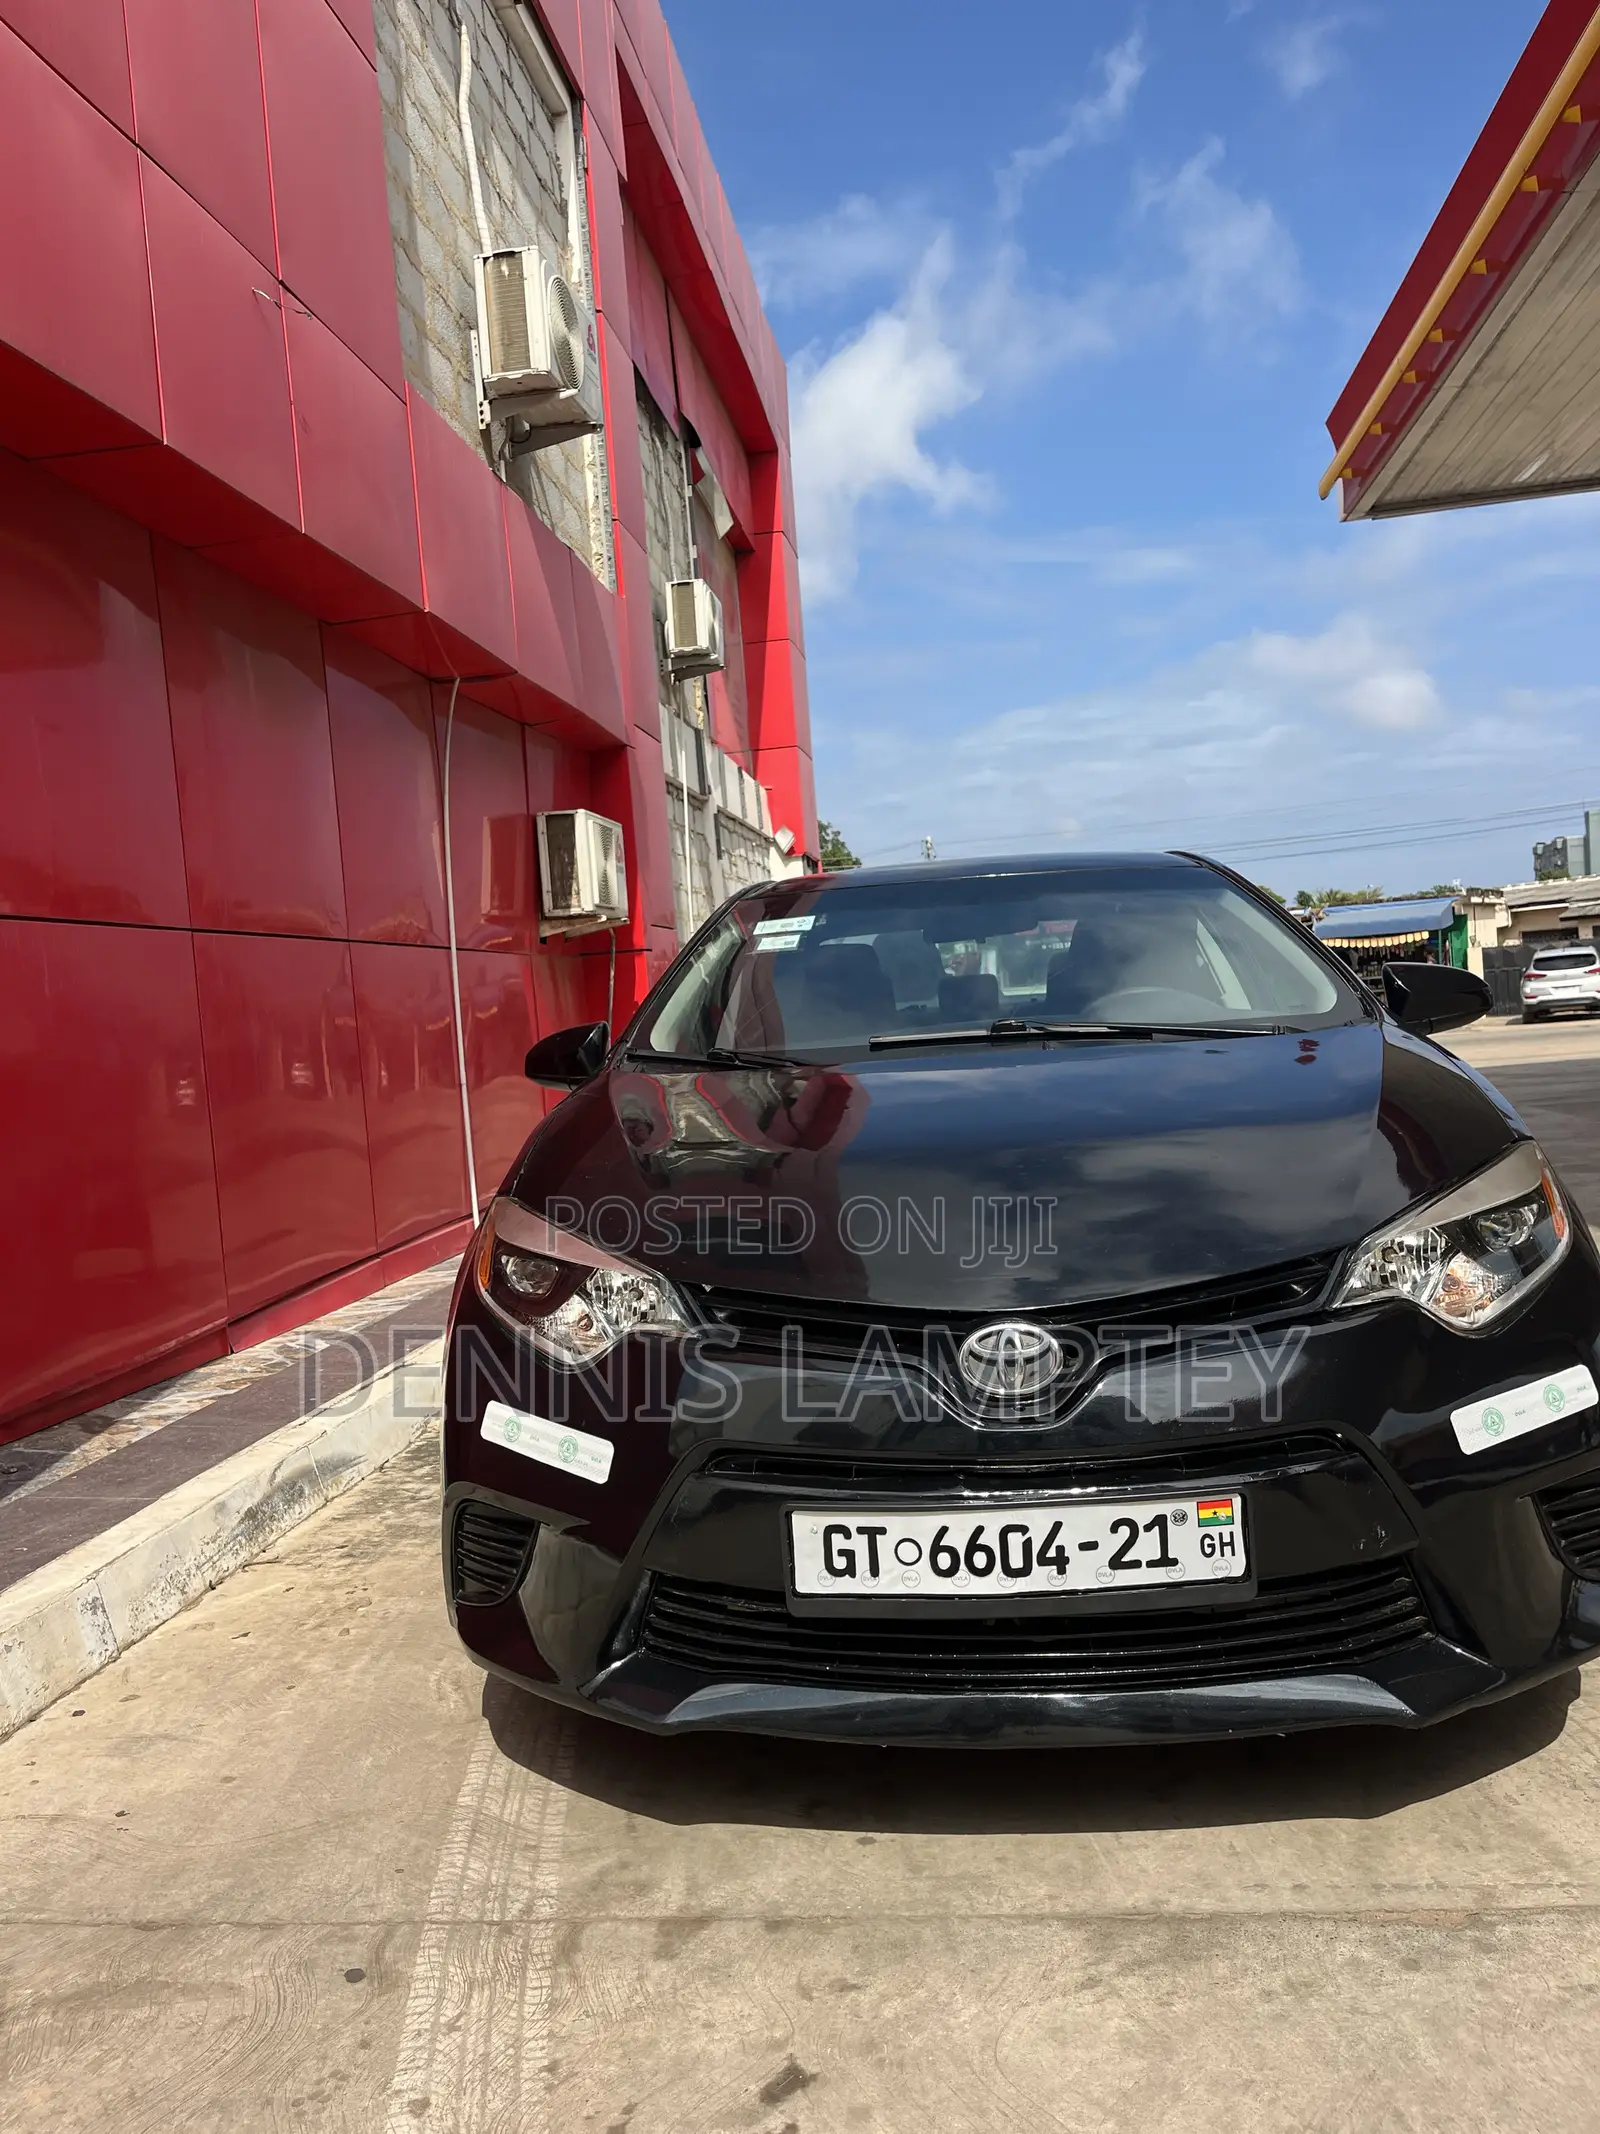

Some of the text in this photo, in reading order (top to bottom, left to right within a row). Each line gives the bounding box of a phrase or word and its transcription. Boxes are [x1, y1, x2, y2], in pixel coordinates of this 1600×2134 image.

[822, 1513, 1179, 1579] GT 6604-21
[1199, 1530, 1236, 1558] GH
